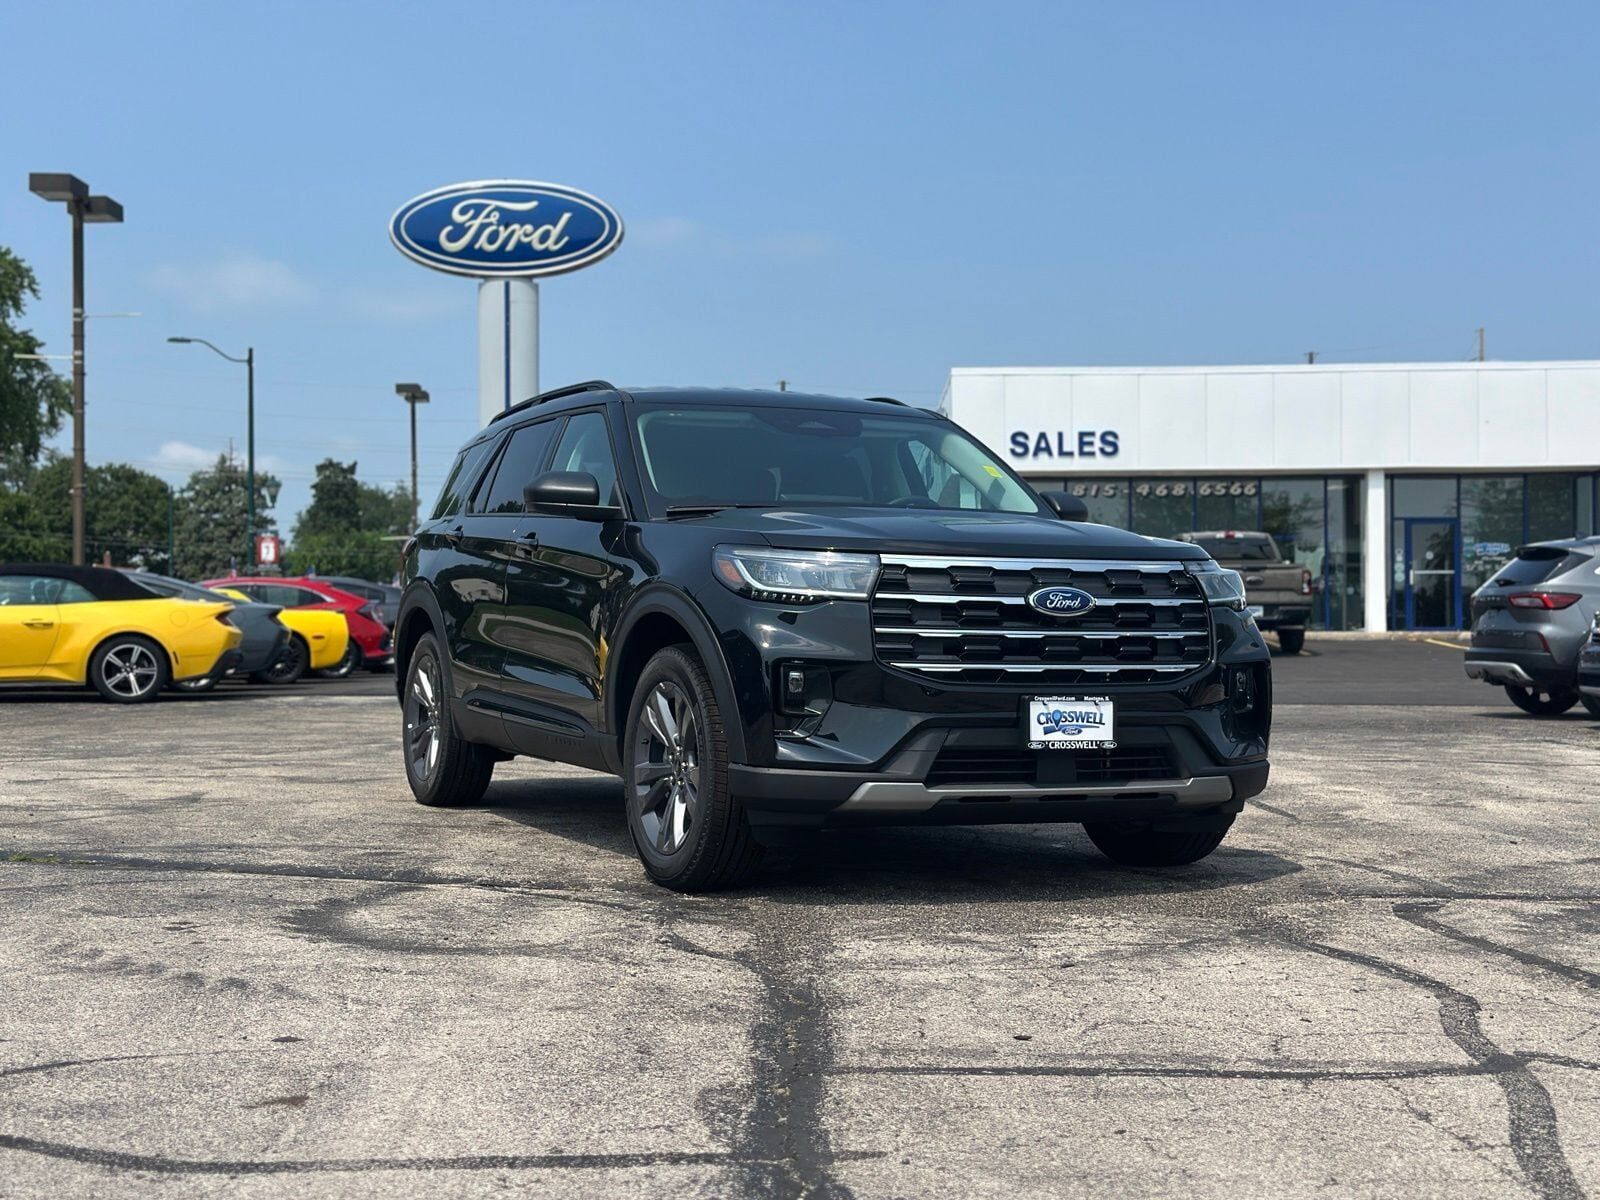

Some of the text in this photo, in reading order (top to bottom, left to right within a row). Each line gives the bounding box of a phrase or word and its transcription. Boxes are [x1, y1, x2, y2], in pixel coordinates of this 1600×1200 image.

[438, 198, 572, 253] Ford
[1009, 430, 1120, 457] SALES
[1046, 592, 1081, 608] Ford
[1037, 710, 1105, 726] CROSSWELL
[1049, 741, 1098, 749] CROSSWELL
